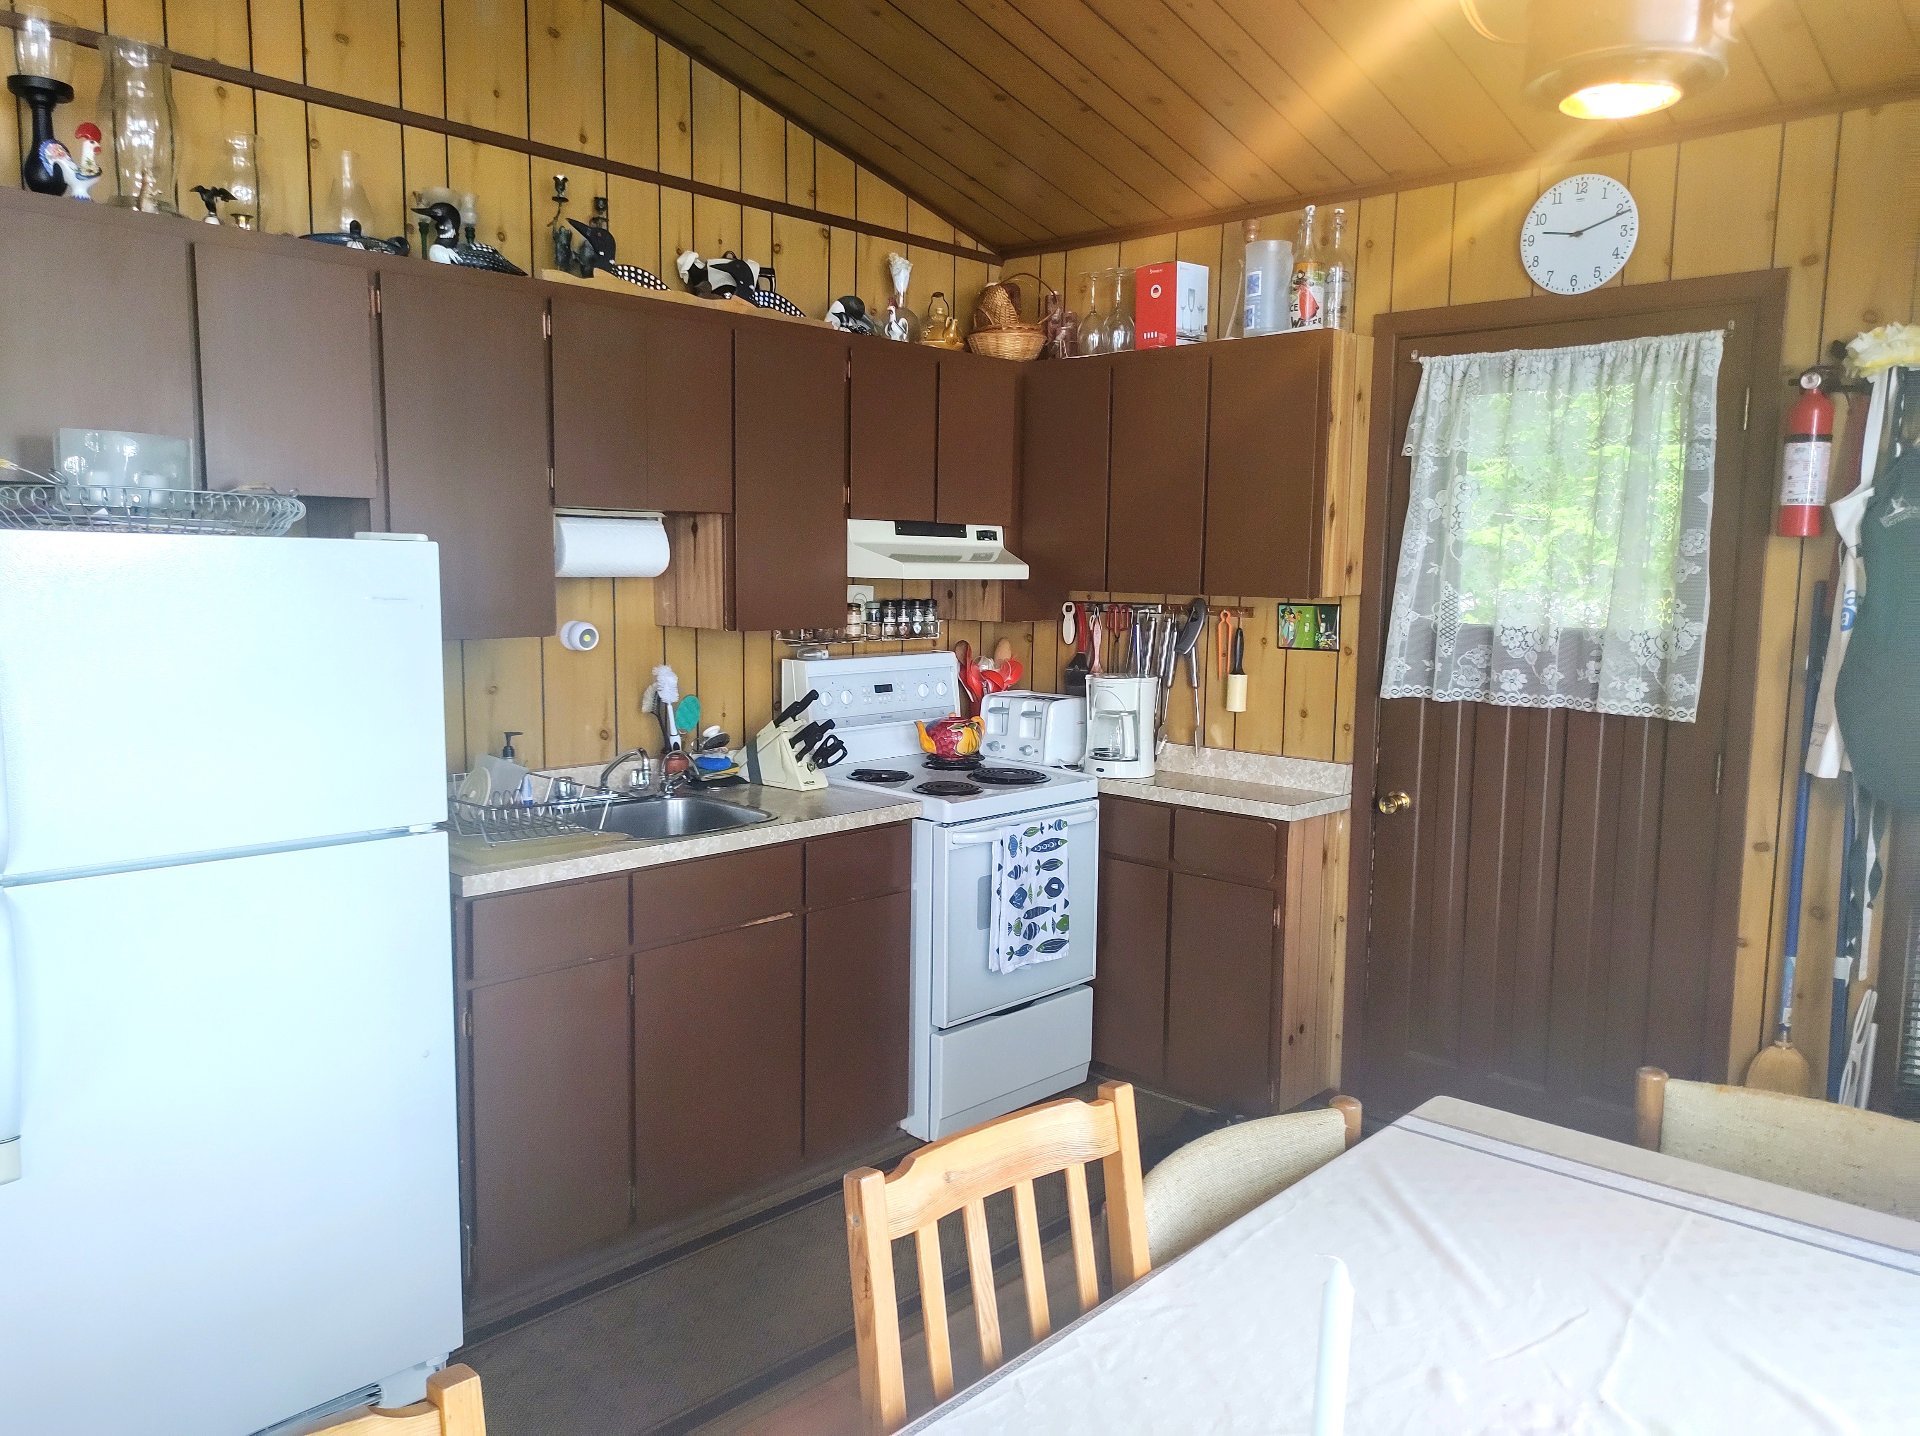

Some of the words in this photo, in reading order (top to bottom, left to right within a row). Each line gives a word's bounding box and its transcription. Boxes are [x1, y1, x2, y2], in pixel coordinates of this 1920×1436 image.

[1575, 181, 1589, 195] 12
[1551, 192, 1563, 205] 11
[1615, 203, 1625, 216] 2
[1535, 213, 1547, 227] 10
[1619, 224, 1628, 237] 3
[1527, 234, 1535, 247] 9
[1611, 246, 1620, 260] 4
[1531, 255, 1540, 268] 8
[1546, 270, 1555, 283] 7
[1593, 266, 1602, 279] 5
[1569, 274, 1578, 287] 6
